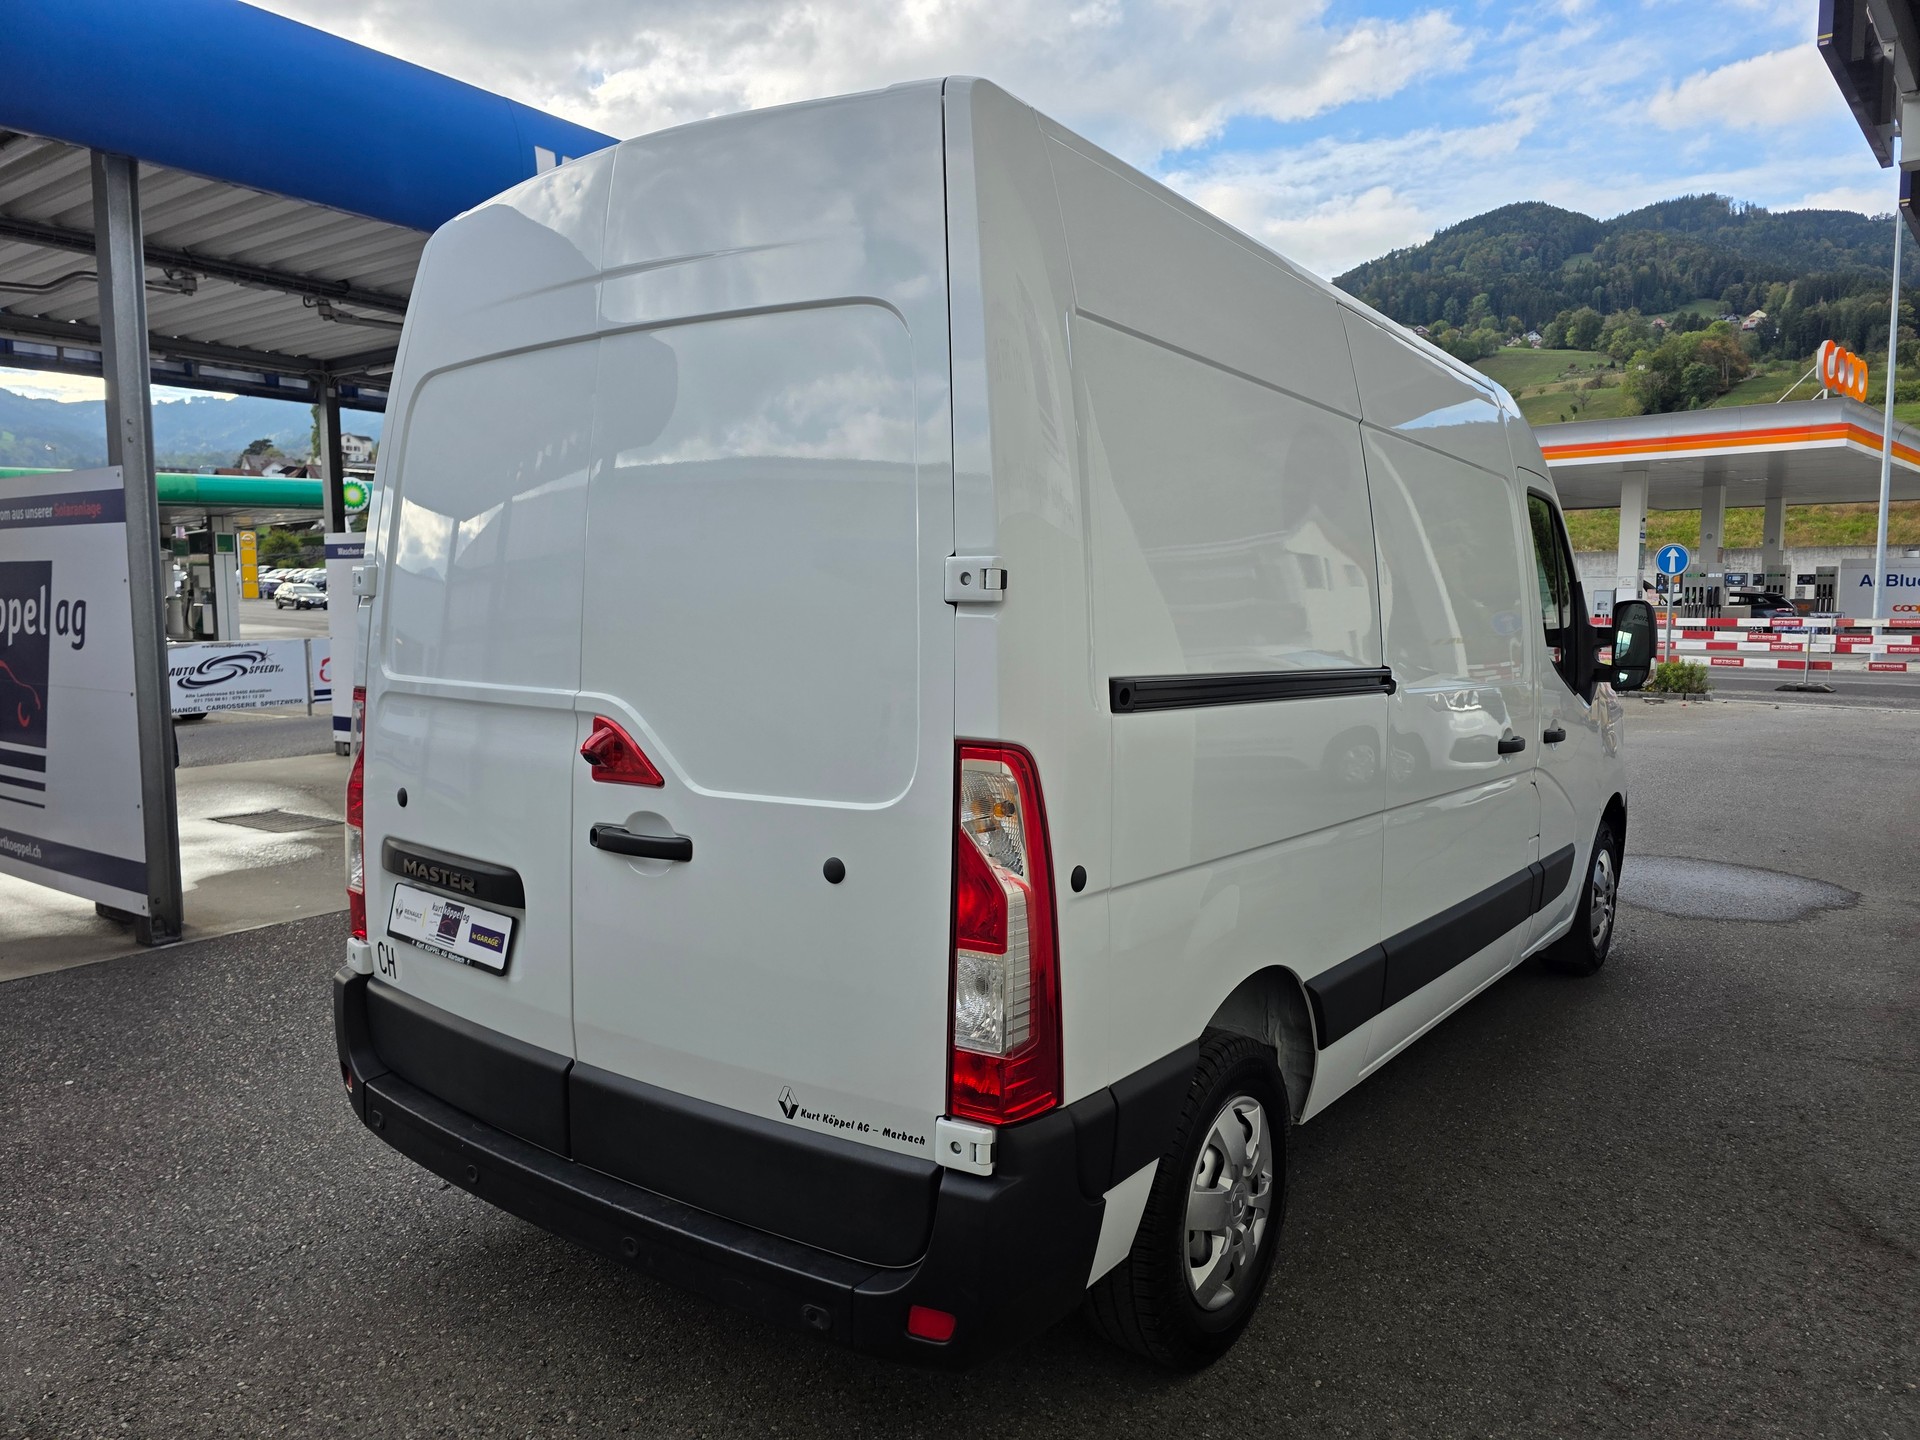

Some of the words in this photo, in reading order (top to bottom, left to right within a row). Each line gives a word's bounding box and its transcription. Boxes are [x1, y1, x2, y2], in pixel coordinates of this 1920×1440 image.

[1820, 340, 1868, 402] coop
[12, 509, 24, 519] aus
[25, 507, 53, 519] unserer
[54, 502, 102, 518] Solaranlage
[1859, 574, 1920, 587] ABlu
[1892, 604, 1920, 613] coo
[56, 600, 86, 650] ag
[169, 666, 195, 677] AUTO
[248, 664, 280, 674] SPEEDY
[171, 706, 203, 714] HANDEL
[206, 702, 257, 711] CARROSSERIE
[260, 698, 304, 707] SPRITZWERK
[403, 858, 475, 894] MASTER
[404, 908, 423, 919] RENAULT
[431, 901, 443, 914] kurt
[443, 905, 463, 920] köppel
[463, 913, 470, 924] ag
[476, 934, 500, 947] GARAGE
[378, 941, 397, 979] CH
[800, 1108, 821, 1121] Kurt
[822, 1113, 855, 1129] Köppel
[857, 1121, 870, 1132] AG
[882, 1127, 926, 1146] Marbach
